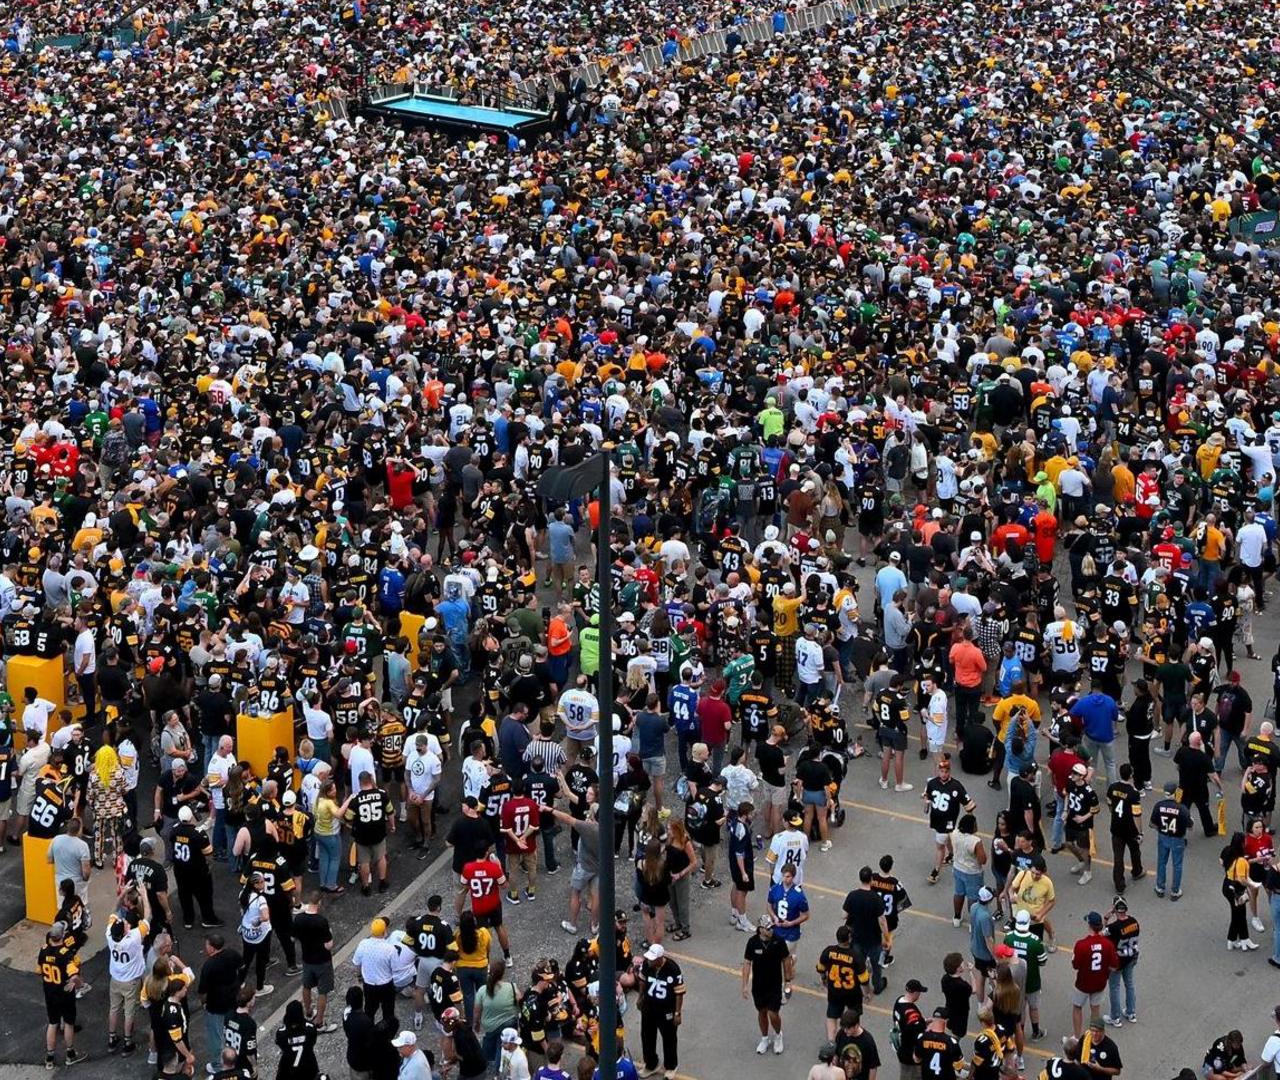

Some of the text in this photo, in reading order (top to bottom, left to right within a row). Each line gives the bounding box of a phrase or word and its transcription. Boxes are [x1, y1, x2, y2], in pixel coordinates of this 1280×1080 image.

[1202, 341, 1214, 352] 90
[1215, 373, 1224, 384] 21
[953, 396, 969, 410] 58
[984, 394, 990, 406] 1
[1118, 423, 1129, 436] 24
[475, 443, 488, 456] 20
[530, 456, 542, 468] 90
[14, 470, 28, 483] 30
[862, 497, 874, 511] 90
[723, 552, 740, 570] 43
[1162, 558, 1174, 570] 15
[1181, 580, 1188, 594] 7
[1104, 590, 1118, 606] 33
[37, 638, 46, 652] 5
[762, 645, 769, 660] 5
[1016, 641, 1036, 662] 88
[1092, 656, 1108, 672] 97
[336, 710, 358, 724] 58
[404, 706, 421, 728] 97
[569, 704, 583, 722] 58
[673, 700, 688, 720] 44
[880, 704, 889, 720] 8
[384, 735, 402, 750] 84
[358, 793, 380, 802] LLOYD
[530, 790, 547, 806] 52
[928, 790, 948, 810] 36
[1069, 794, 1081, 812] 55
[31, 796, 58, 827] 26
[358, 802, 382, 822] 95
[1114, 800, 1122, 818] 4
[1160, 816, 1176, 834] 54
[174, 843, 190, 861] 50
[786, 848, 802, 866] 84
[470, 878, 491, 897] 97
[778, 900, 788, 920] 6
[418, 932, 435, 950] 90
[112, 950, 130, 964] 90
[1090, 952, 1101, 970] 2
[42, 963, 62, 984] 90
[828, 966, 853, 989] 43
[646, 978, 667, 999] 75
[292, 1046, 304, 1066] 7
[930, 1053, 941, 1075] 4
